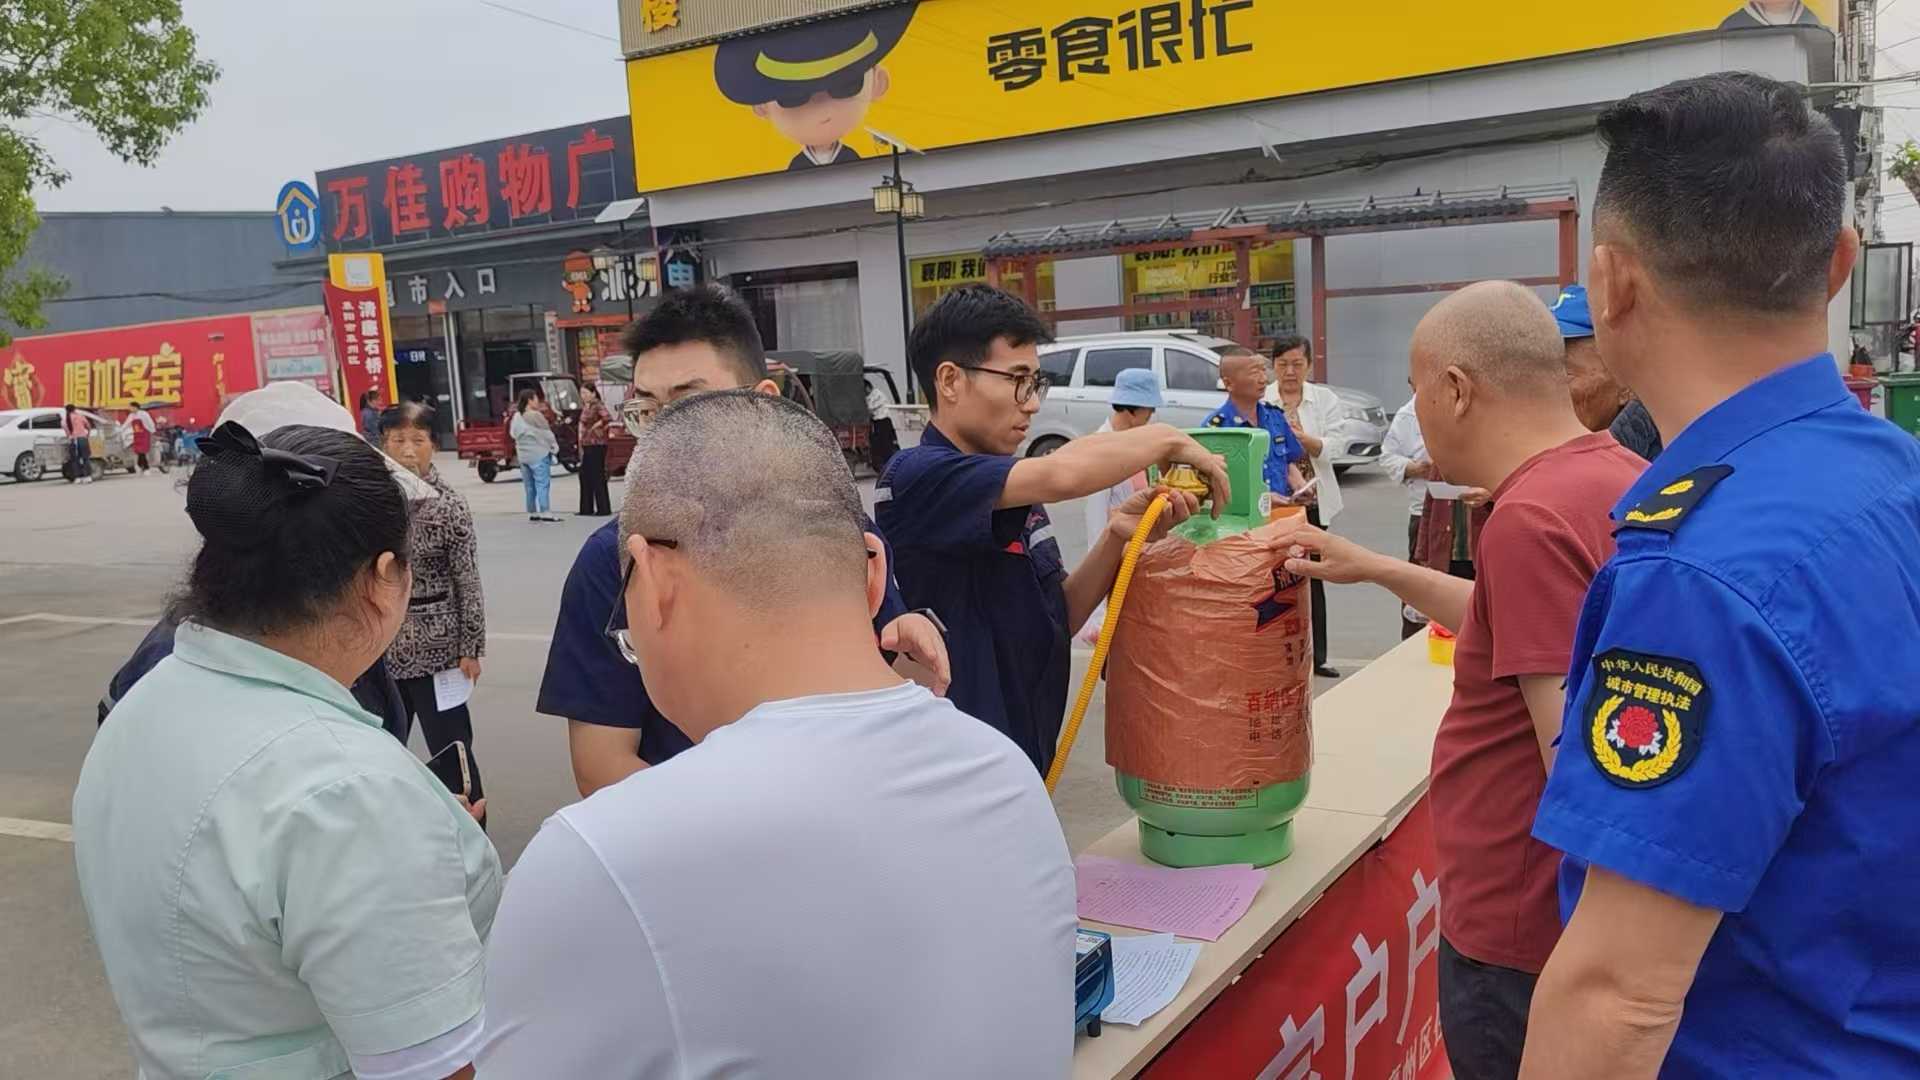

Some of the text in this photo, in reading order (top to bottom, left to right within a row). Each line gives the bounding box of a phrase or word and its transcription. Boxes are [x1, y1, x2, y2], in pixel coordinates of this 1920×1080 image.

[987, 0, 1254, 92] 零食很忙
[328, 128, 616, 241] 万佳购物广
[63, 342, 184, 410] 喝加多宝
[1601, 658, 1703, 697] 中华人民共和国
[1605, 675, 1693, 711] 城市管理执法
